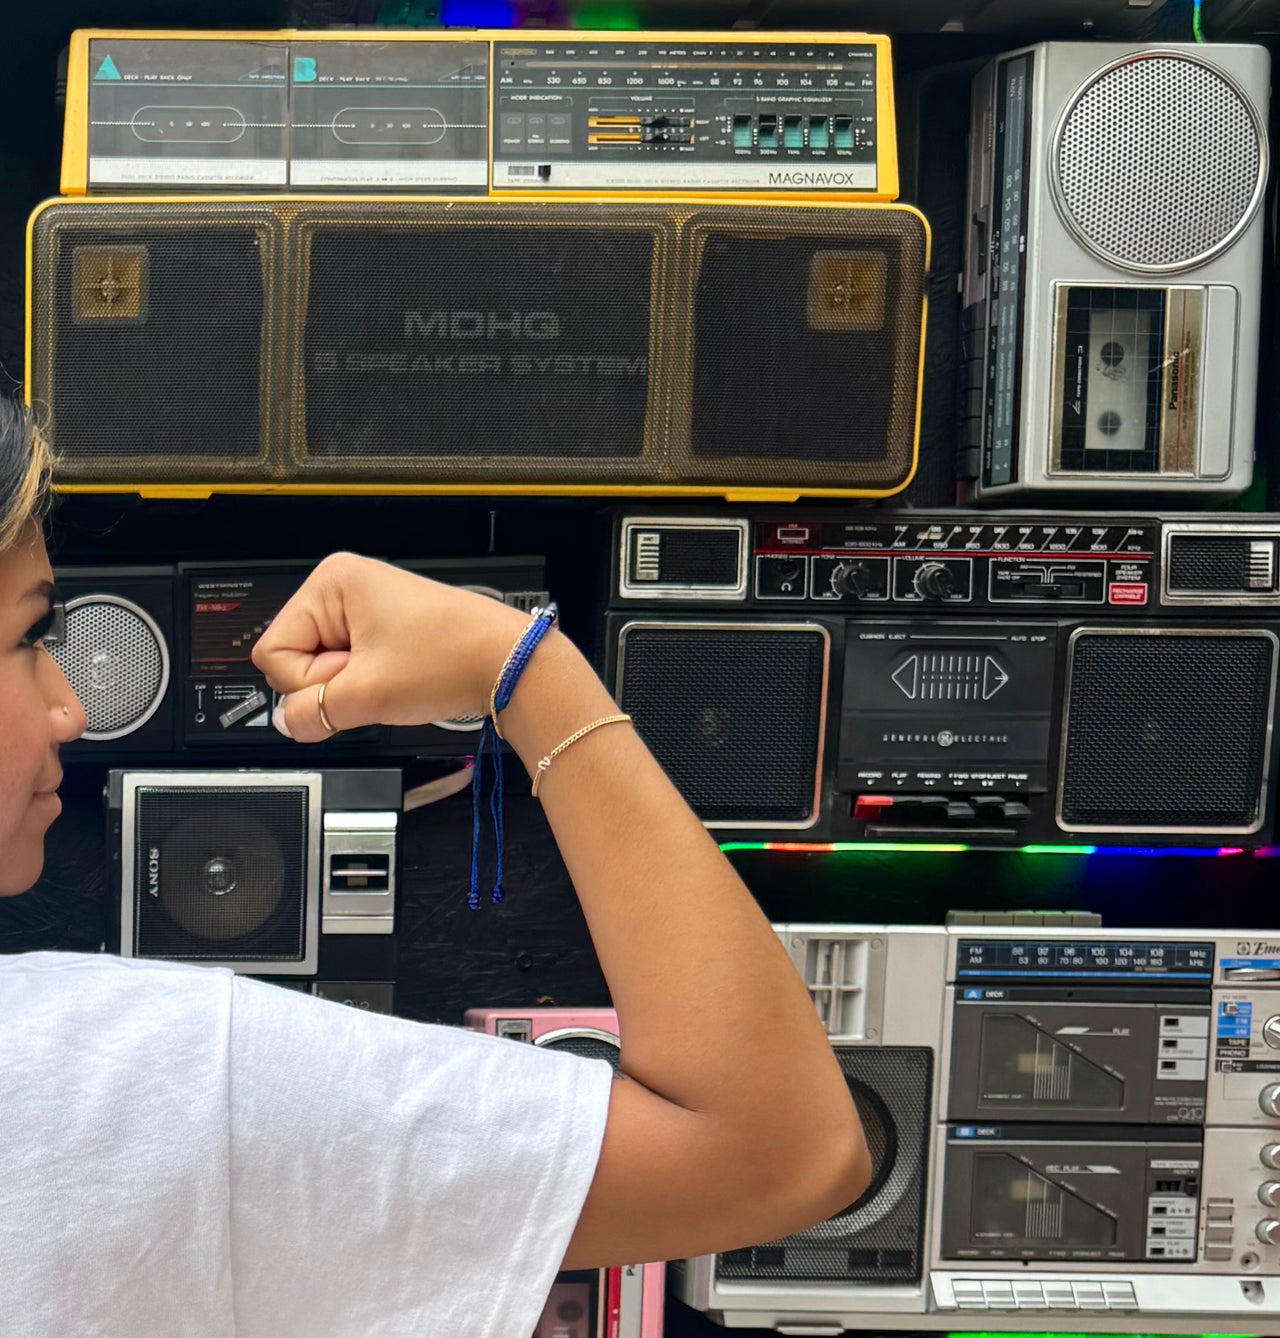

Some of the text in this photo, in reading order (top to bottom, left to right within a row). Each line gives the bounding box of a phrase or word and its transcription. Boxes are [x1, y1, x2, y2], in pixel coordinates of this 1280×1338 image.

[572, 77, 587, 85] 650
[598, 77, 612, 85] 850
[626, 77, 643, 85] 1200
[658, 77, 675, 85] 1600
[768, 173, 854, 185] MAGNAVOX
[345, 352, 501, 376] SPEAKER
[511, 352, 648, 376] SYSTEM
[1168, 351, 1180, 410] Panasonic
[883, 734, 936, 742] GENERAL
[954, 735, 1008, 743] ELECTRIC
[149, 847, 159, 898] SONY
[970, 947, 982, 955] FM
[1091, 948, 1106, 956] 100
[1119, 948, 1133, 956] 104
[1150, 949, 1164, 957] 108
[1190, 950, 1207, 958] MHz
[970, 956, 982, 964] AM
[968, 990, 978, 999] A
